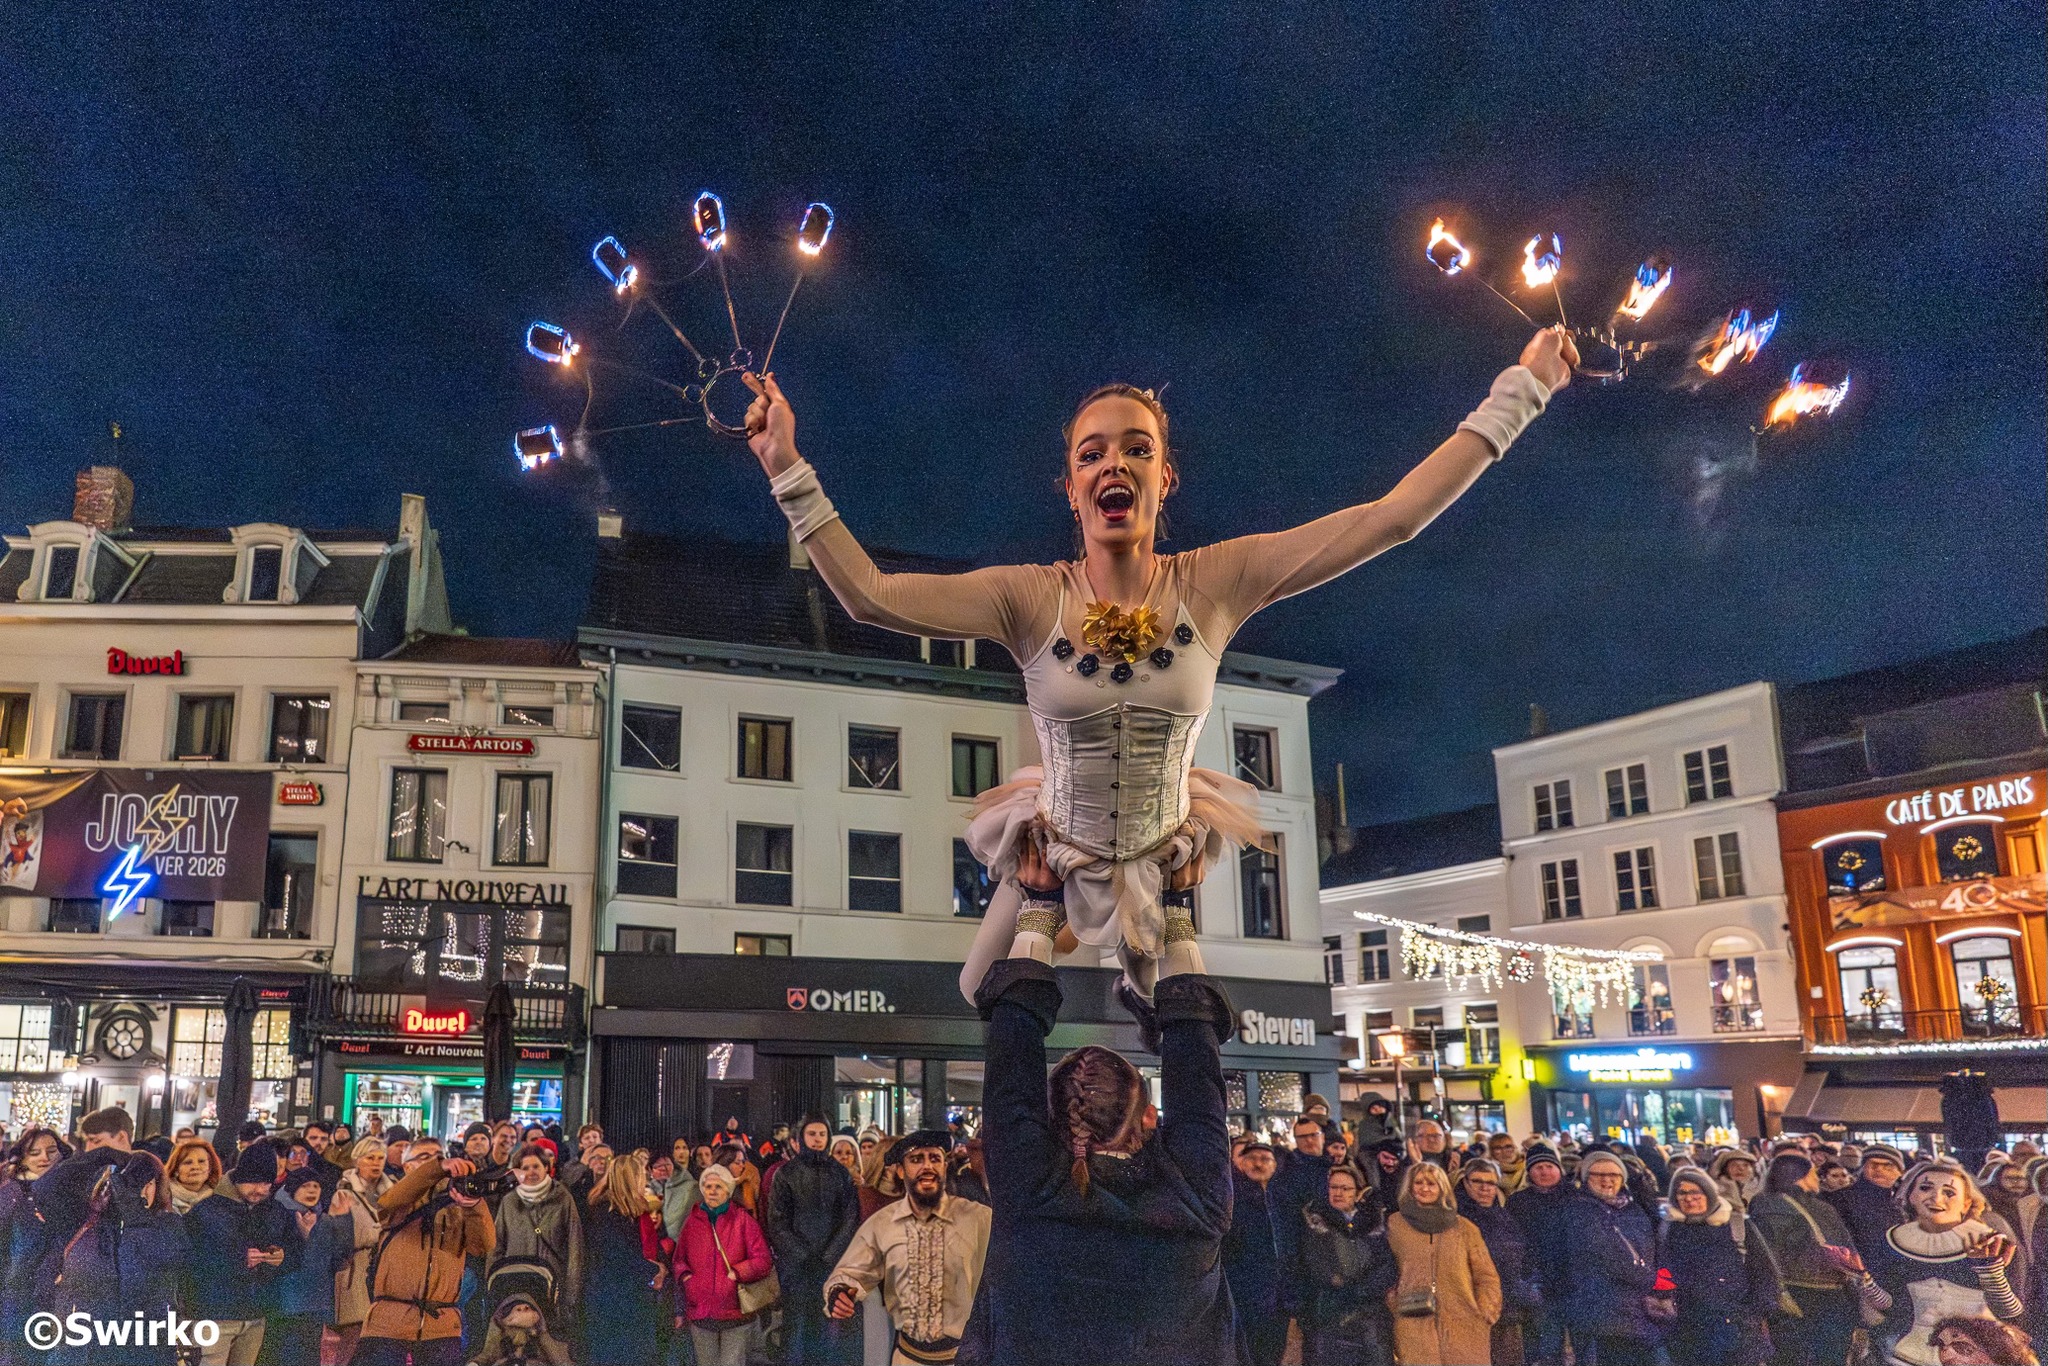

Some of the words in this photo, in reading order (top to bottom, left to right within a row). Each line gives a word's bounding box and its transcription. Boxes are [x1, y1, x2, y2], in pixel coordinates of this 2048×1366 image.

[107, 646, 182, 675] Duvel
[417, 737, 466, 749] STELLA
[473, 740, 523, 752] ARTOIS
[1886, 789, 1936, 825] CAFÉ
[1939, 788, 1968, 821] DE
[1972, 776, 2034, 812] PARIS
[85, 794, 239, 854] JOSHY
[188, 857, 226, 877] 2026
[406, 1010, 466, 1033] Duvel
[1240, 1009, 1315, 1046] Steven
[341, 1042, 370, 1053] Duvel
[418, 1044, 434, 1056] Art
[521, 1049, 551, 1060] Duvel
